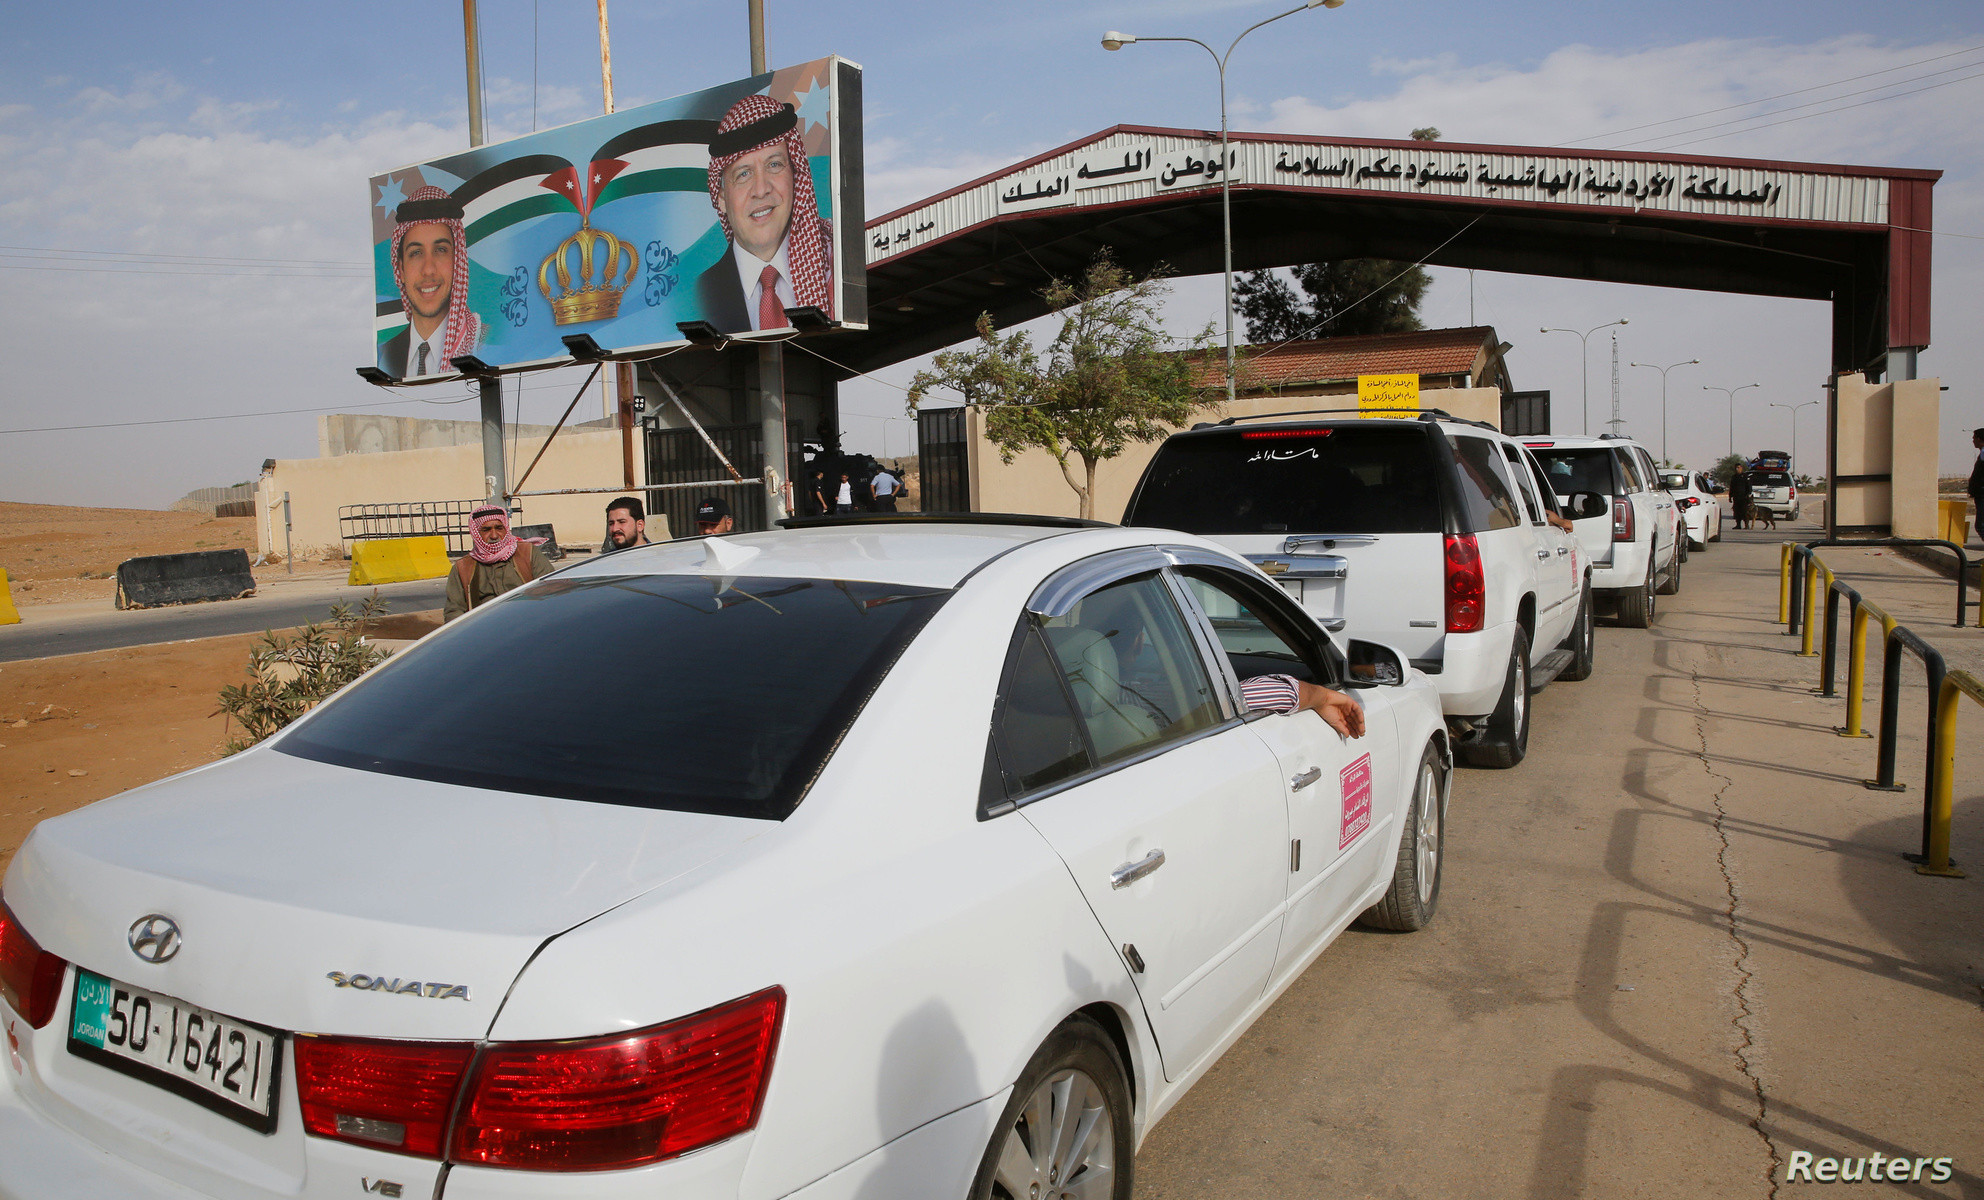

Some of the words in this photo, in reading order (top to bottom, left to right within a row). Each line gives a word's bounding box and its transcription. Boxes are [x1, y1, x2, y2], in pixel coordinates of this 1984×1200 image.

[1077, 147, 1151, 180] الله
[1161, 149, 1235, 187] الوطن
[1275, 151, 1354, 177] السلامة
[1354, 156, 1470, 187] تستودعكم
[1002, 175, 1070, 204] الملك
[1477, 163, 1581, 198] الهاشمية
[1584, 166, 1675, 201] الأردنية
[1681, 174, 1782, 208] المملكة
[872, 218, 935, 251] مديرية
[325, 970, 472, 1001] SONATA
[76, 1021, 105, 1041] JORDAN
[361, 1175, 404, 1199] V6
